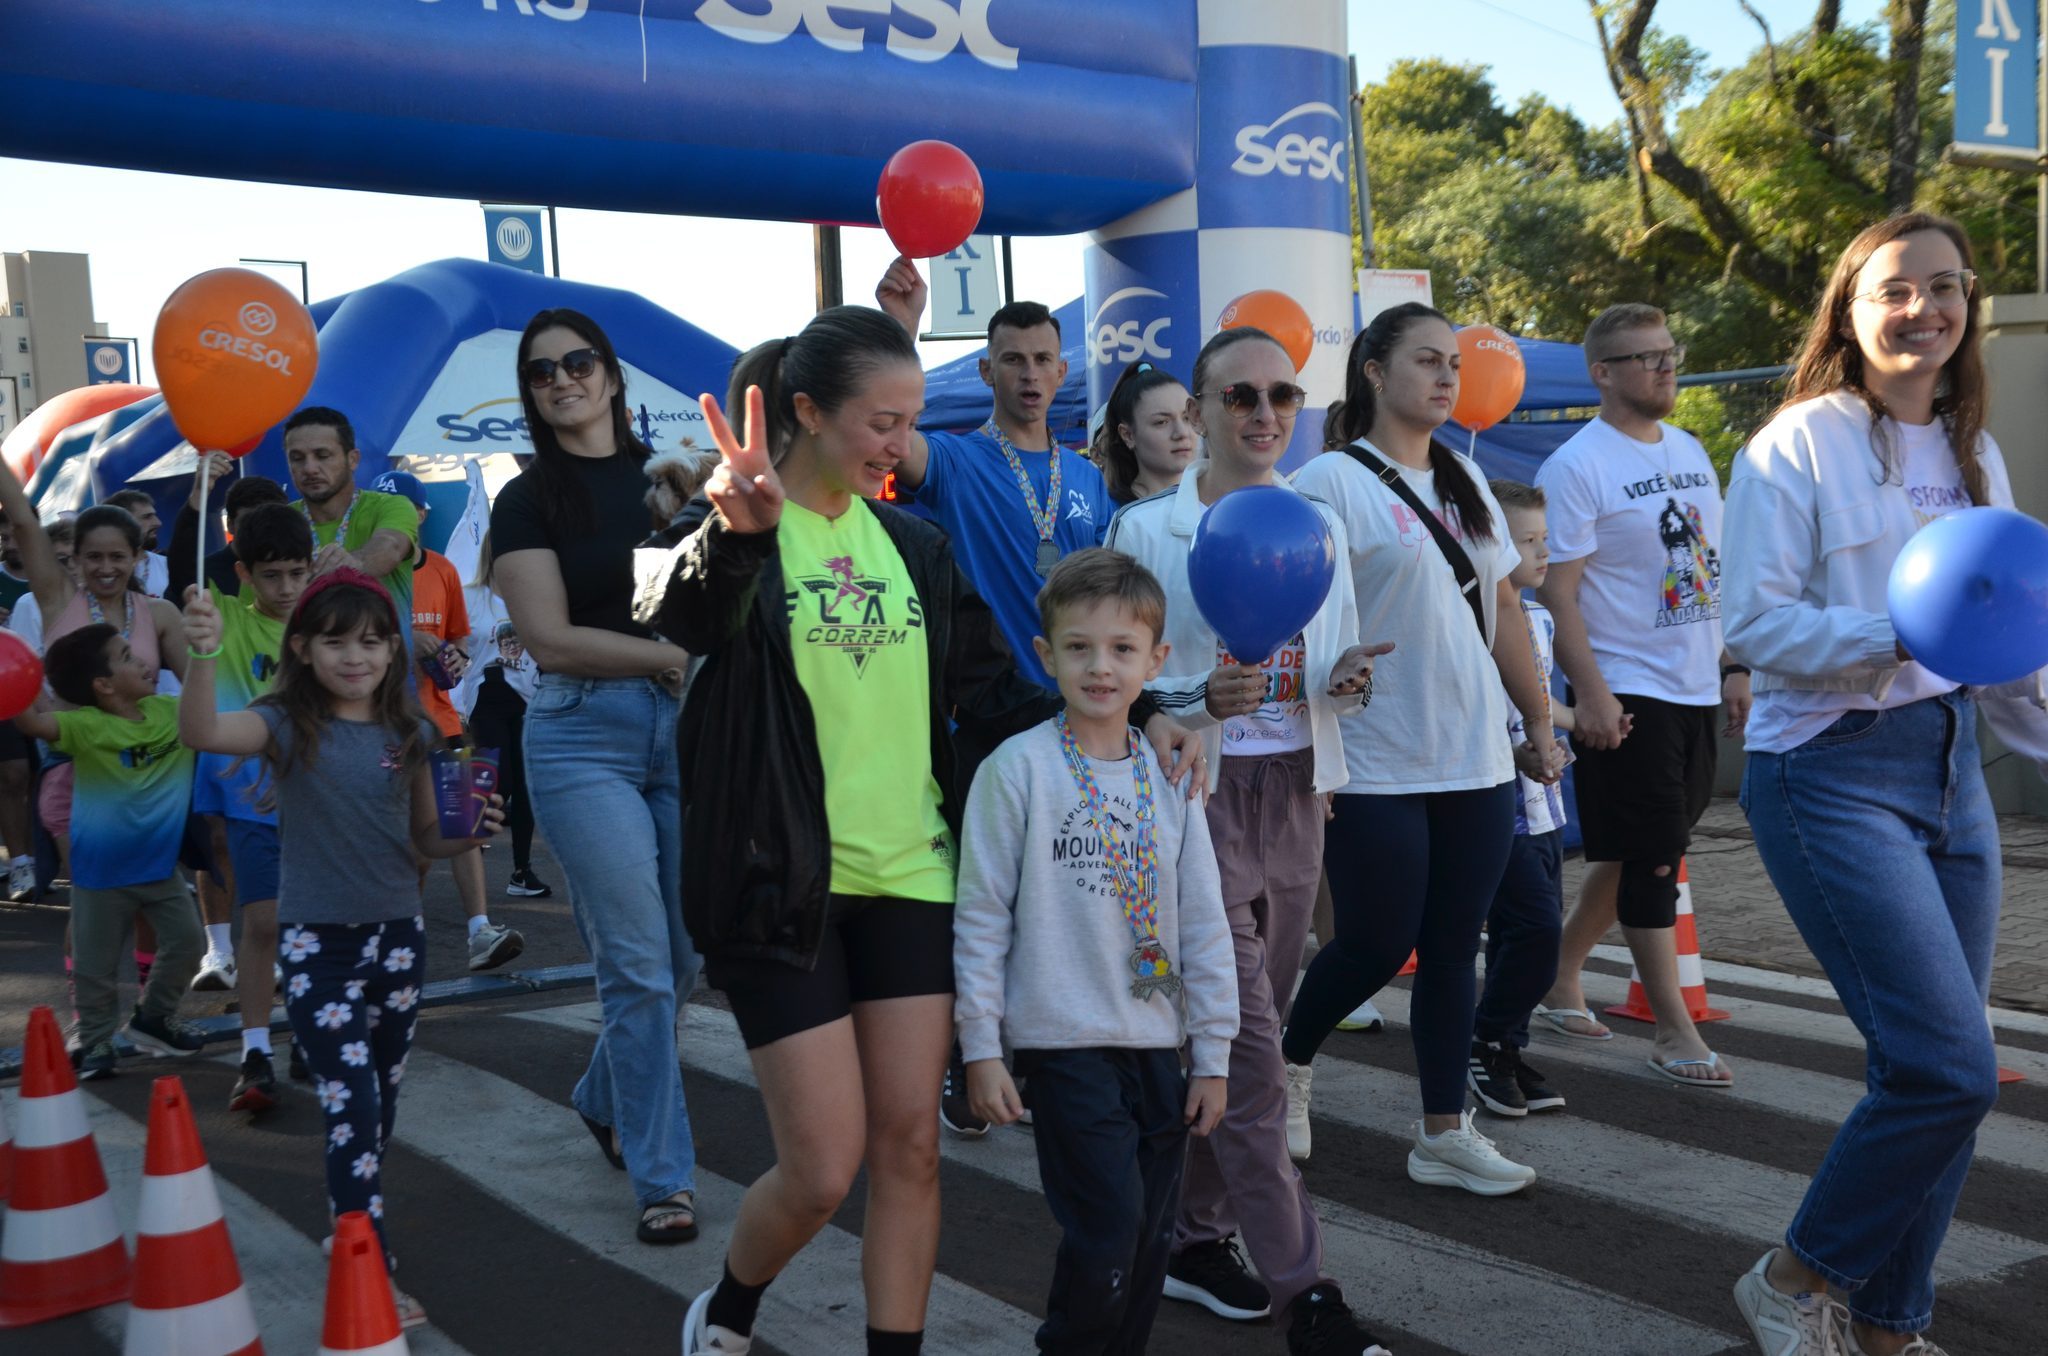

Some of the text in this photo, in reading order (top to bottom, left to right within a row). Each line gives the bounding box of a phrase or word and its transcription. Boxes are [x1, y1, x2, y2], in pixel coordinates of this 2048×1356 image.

[1312, 323, 1341, 345] rcio
[198, 329, 292, 377] CRESOL
[1476, 339, 1521, 362] CRESO
[632, 409, 705, 422] mércio
[436, 413, 531, 443] Ses
[377, 475, 398, 493] LA
[806, 627, 908, 645] CORREM
[1280, 649, 1305, 669] DE
[1060, 792, 1132, 835] EXPLOS ALL
[1076, 877, 1118, 897] OREG
